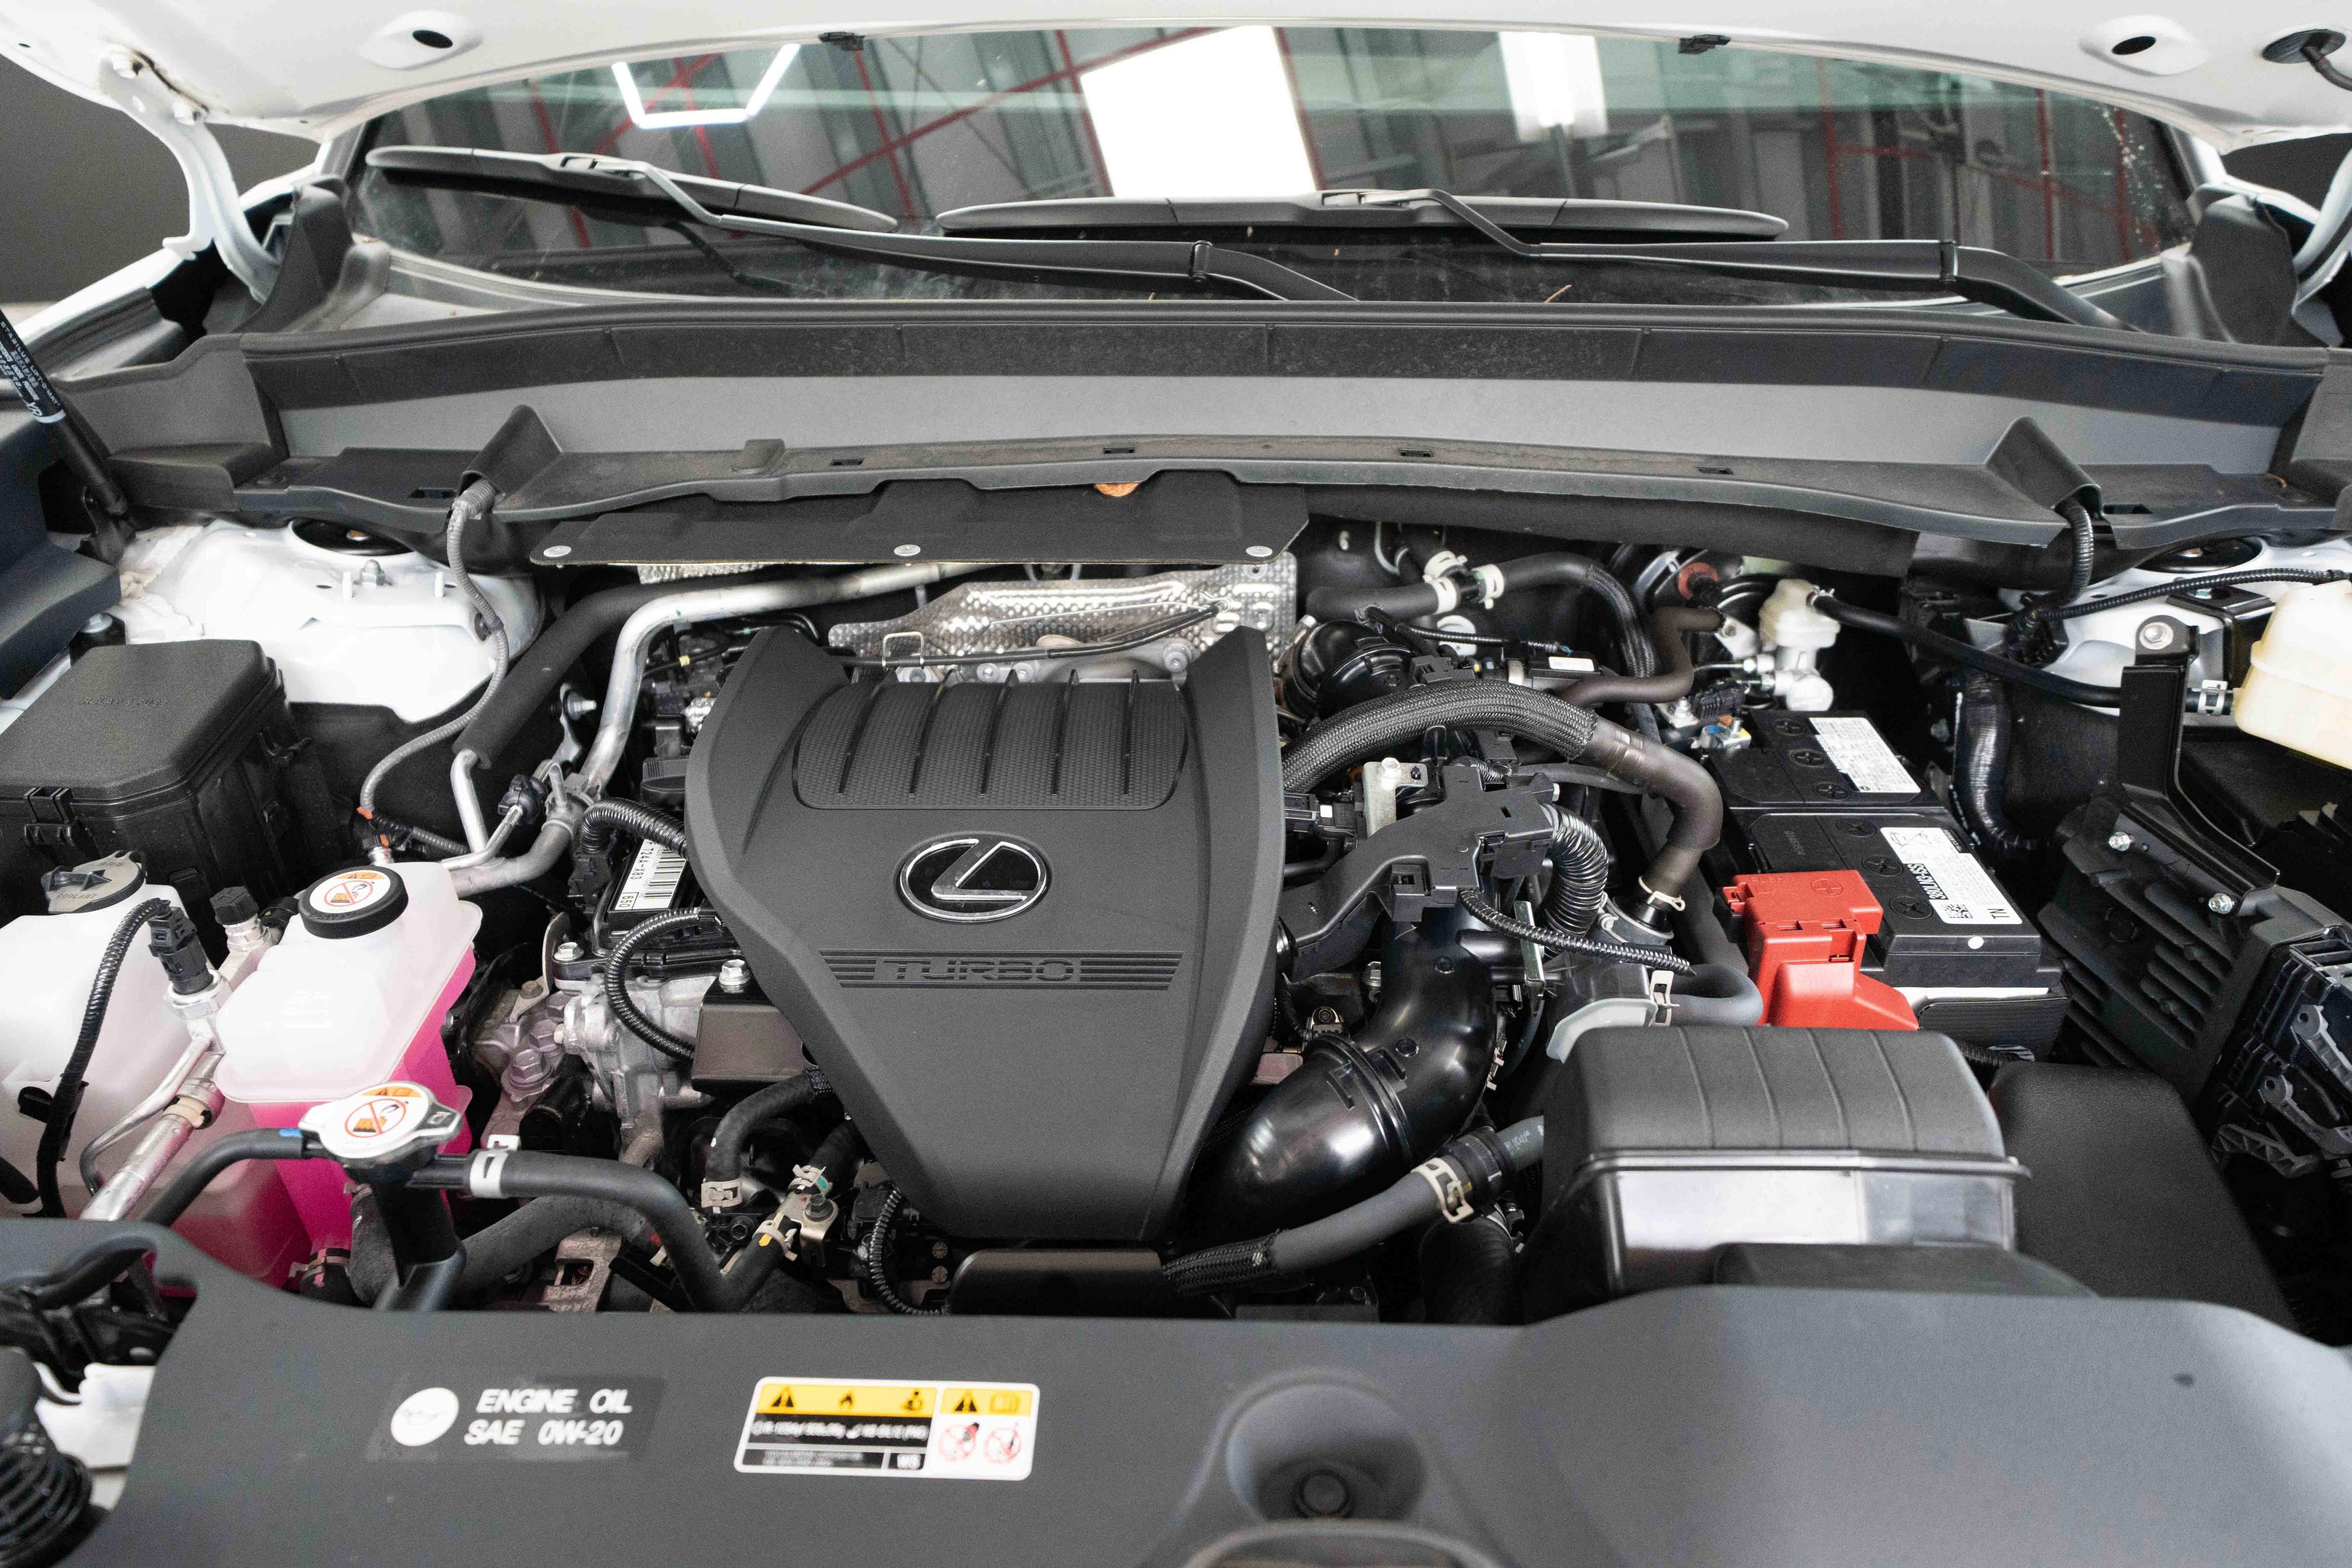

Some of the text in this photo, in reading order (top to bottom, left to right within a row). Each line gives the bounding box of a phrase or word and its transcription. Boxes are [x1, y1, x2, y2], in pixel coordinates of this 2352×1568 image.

[1907, 864, 1948, 900] 380LN3-ISS
[618, 895, 634, 908] 650
[1987, 908, 2010, 920] TN
[883, 958, 1074, 981] TURBO
[476, 1388, 633, 1414] ENGINE OIL
[464, 1419, 624, 1446] SAE 0W-20
